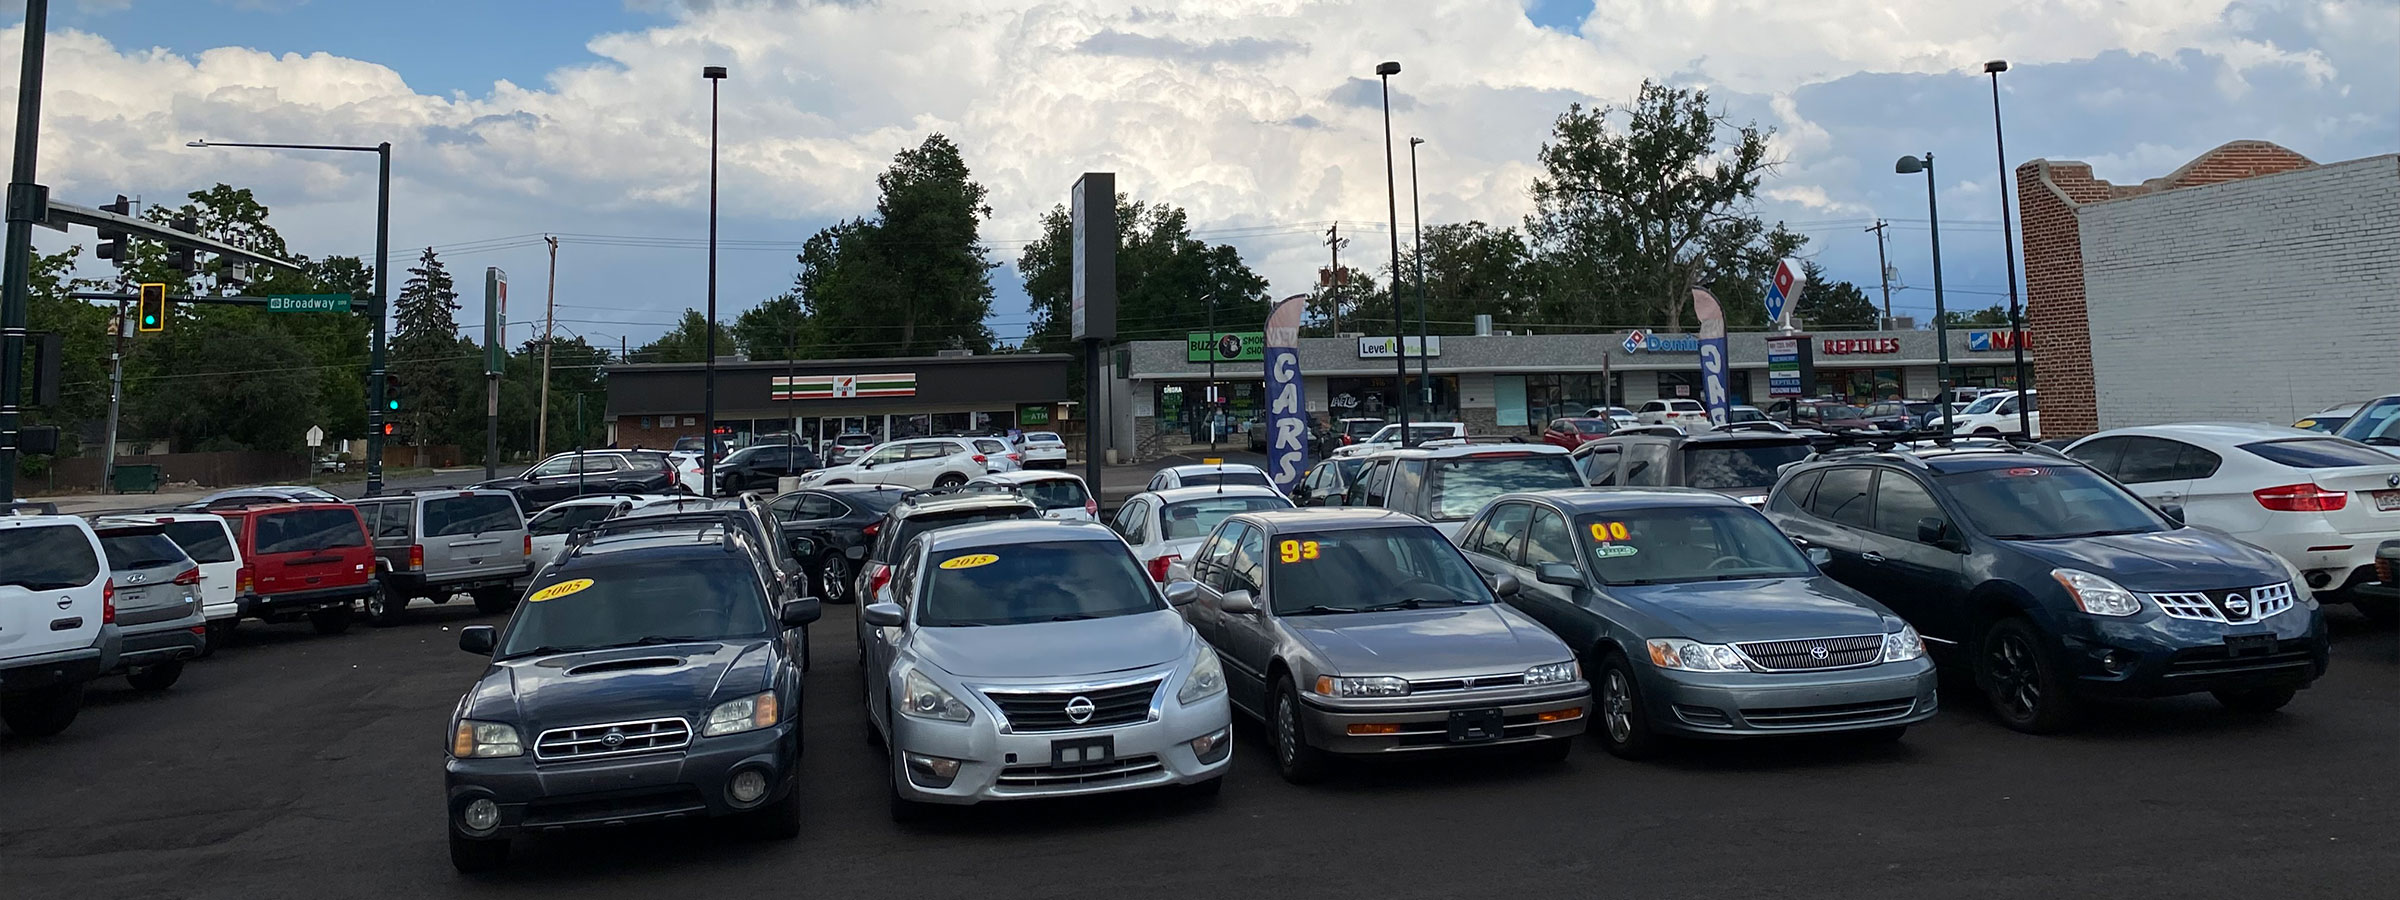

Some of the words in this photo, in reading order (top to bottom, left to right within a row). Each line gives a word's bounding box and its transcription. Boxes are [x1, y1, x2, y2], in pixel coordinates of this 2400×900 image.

[283, 297, 335, 311] Broadway
[1190, 340, 1219, 352] BUZZ
[1242, 336, 1264, 345] SMOK
[1823, 337, 1900, 355] REPTILES
[1991, 330, 2033, 349] NAIL
[1246, 346, 1264, 355] SHO
[1362, 342, 1388, 354] Level
[1031, 412, 1048, 420] ATM
[1272, 352, 1305, 485] CARS
[1591, 521, 1628, 541] 00
[1281, 540, 1319, 562] 93
[950, 556, 989, 567] 2015
[541, 580, 583, 600] 2005
